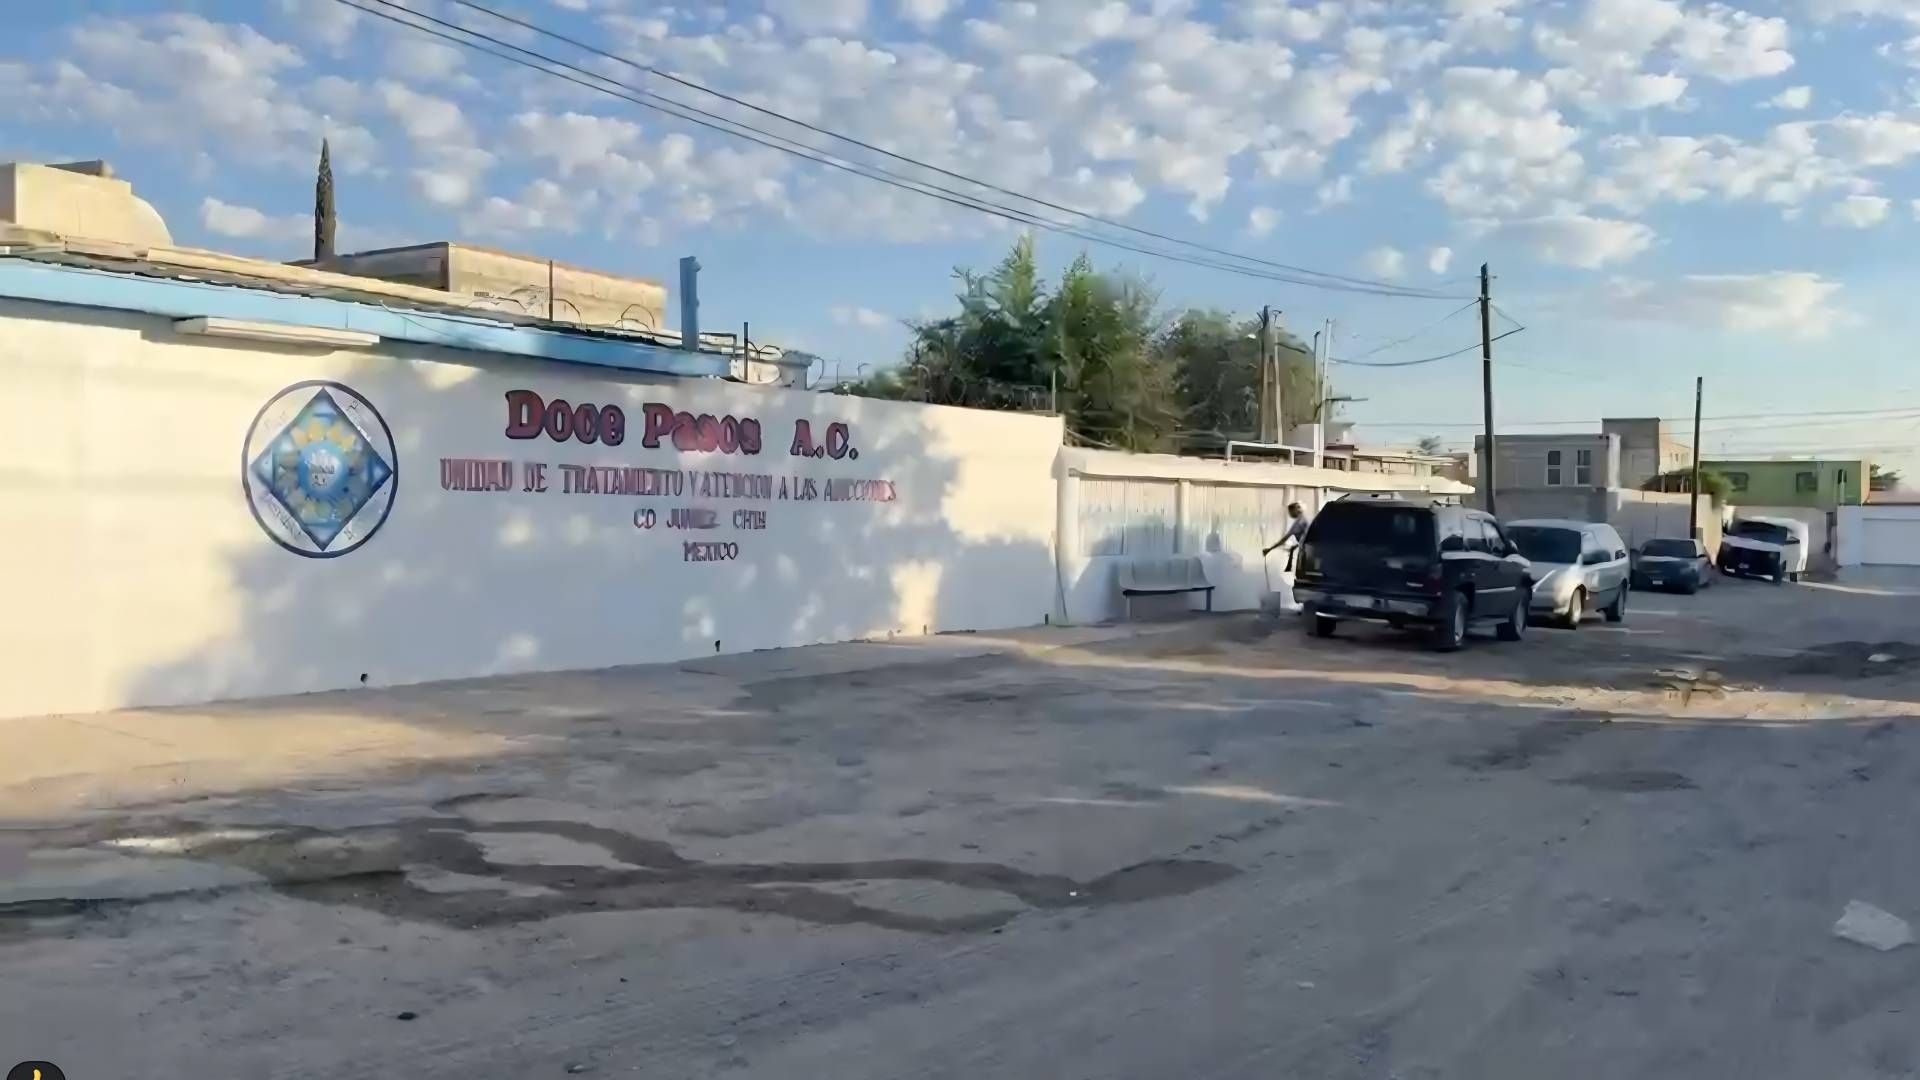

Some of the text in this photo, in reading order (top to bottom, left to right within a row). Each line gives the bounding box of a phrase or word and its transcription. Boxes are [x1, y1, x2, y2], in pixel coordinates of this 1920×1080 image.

[790, 418, 859, 460] A.C.
[523, 462, 548, 492] DE
[779, 475, 789, 500] A
[794, 476, 818, 501] LAS
